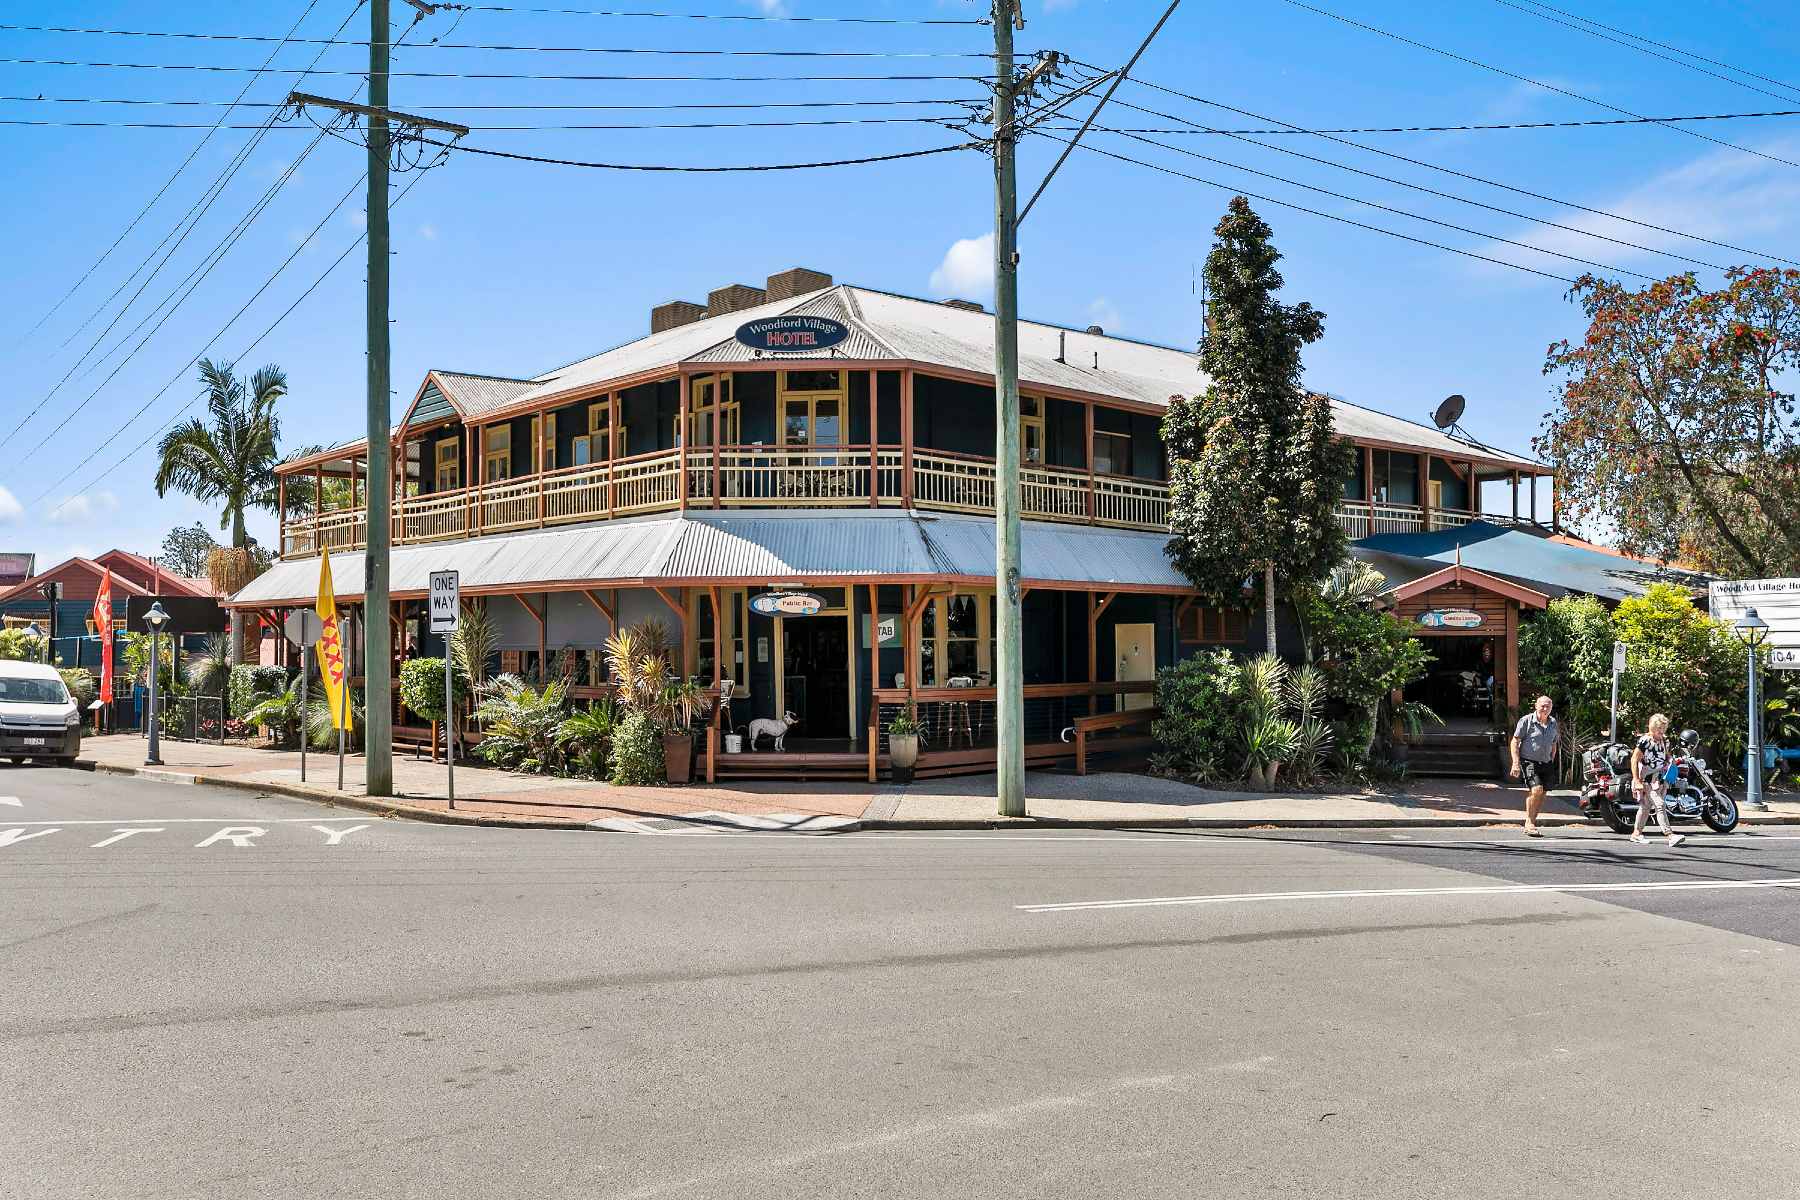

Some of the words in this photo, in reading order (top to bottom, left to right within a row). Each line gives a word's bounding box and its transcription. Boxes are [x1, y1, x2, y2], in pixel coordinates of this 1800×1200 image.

[749, 317, 801, 335] Woodford
[803, 318, 838, 333] Village
[767, 331, 818, 346] HOTEL
[434, 577, 455, 591] ONE
[1758, 582, 1786, 592] Village
[433, 595, 455, 609] WAY
[878, 626, 893, 636] TAB
